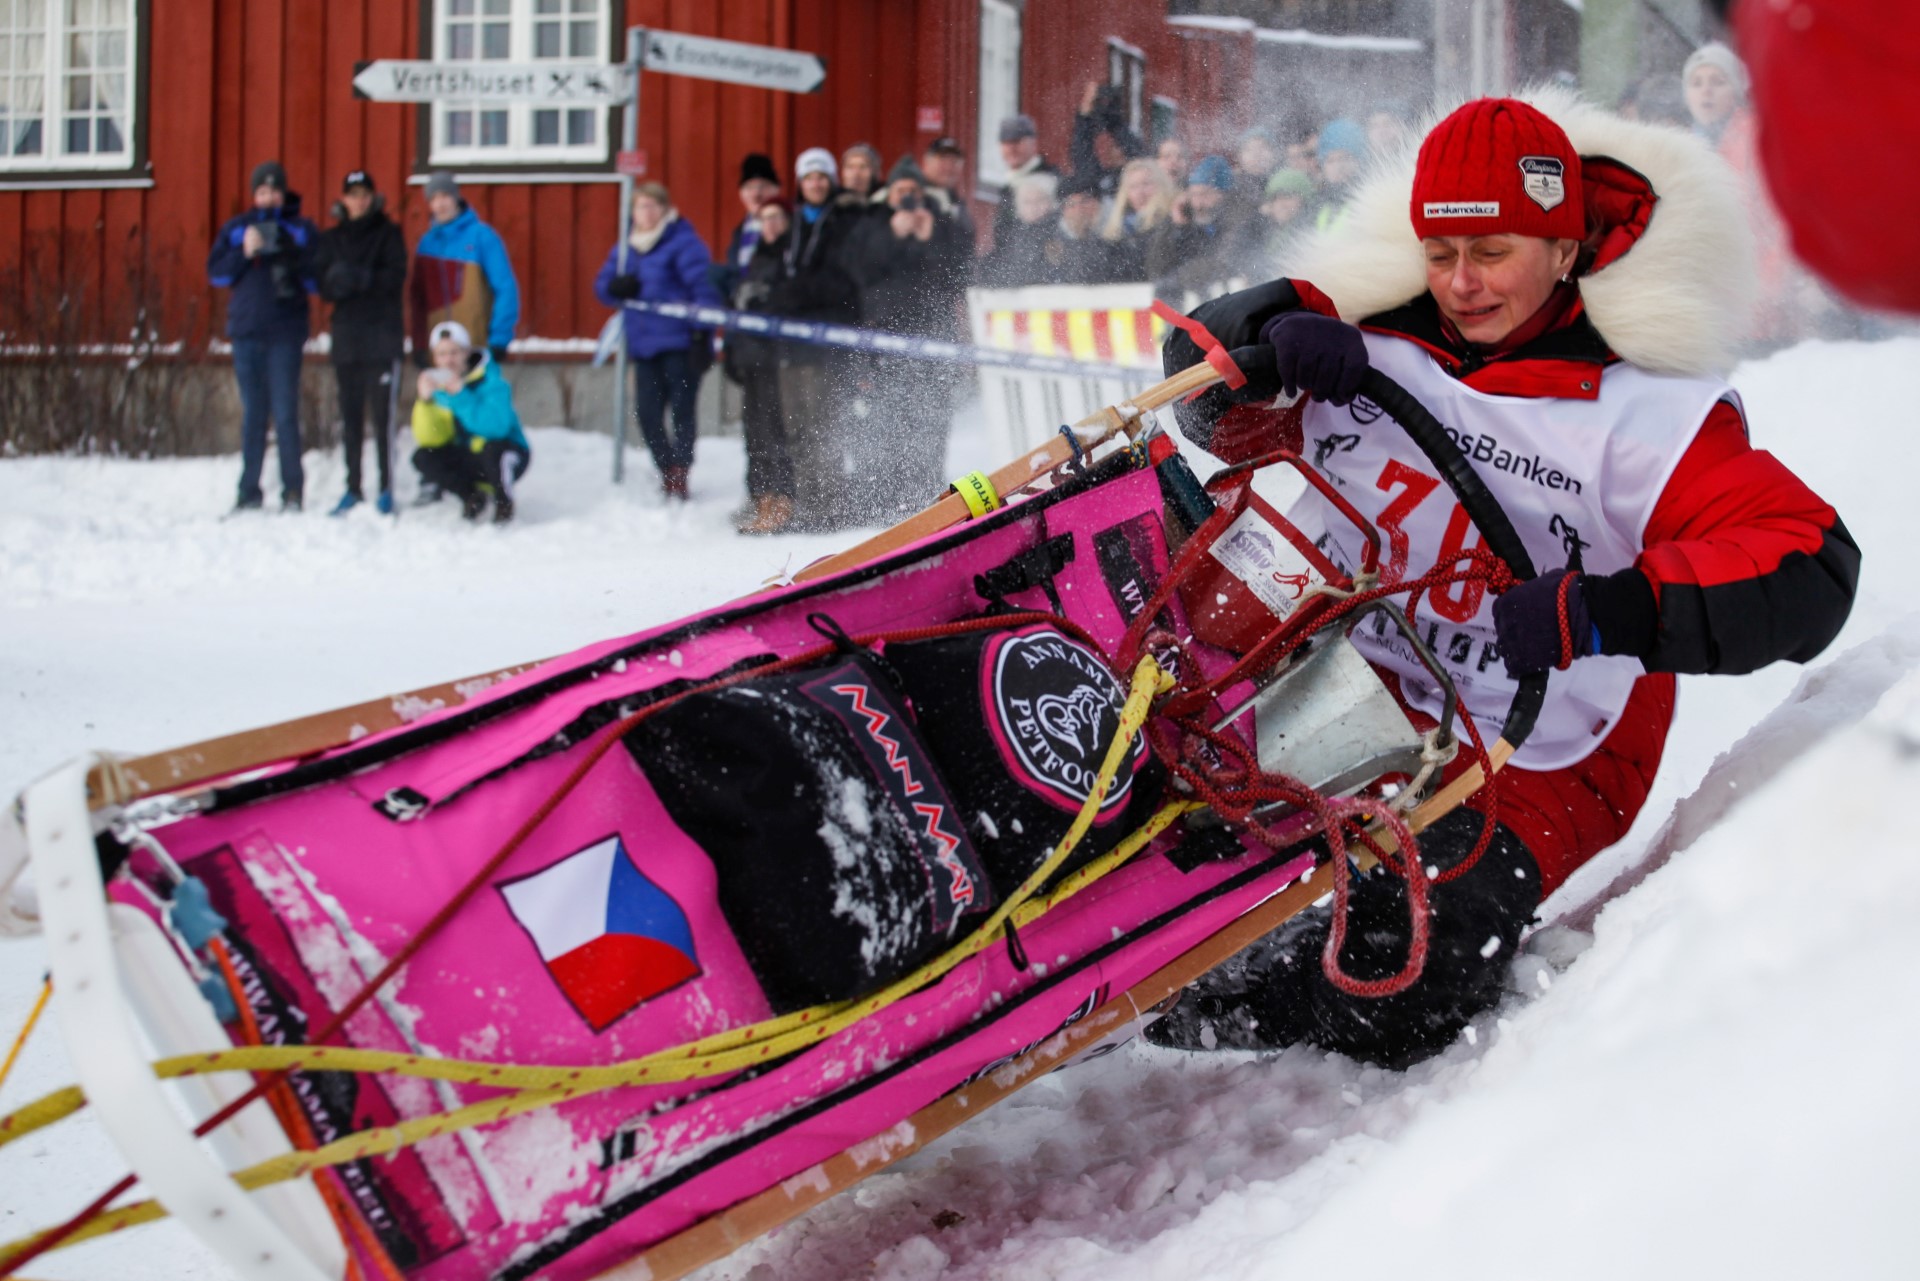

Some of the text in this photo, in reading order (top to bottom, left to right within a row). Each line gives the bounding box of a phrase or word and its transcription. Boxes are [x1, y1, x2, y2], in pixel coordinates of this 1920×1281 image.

[392, 67, 536, 93] Vertshuset
[1426, 203, 1496, 215] norskamoda.cz
[1392, 414, 1583, 496] osBanken
